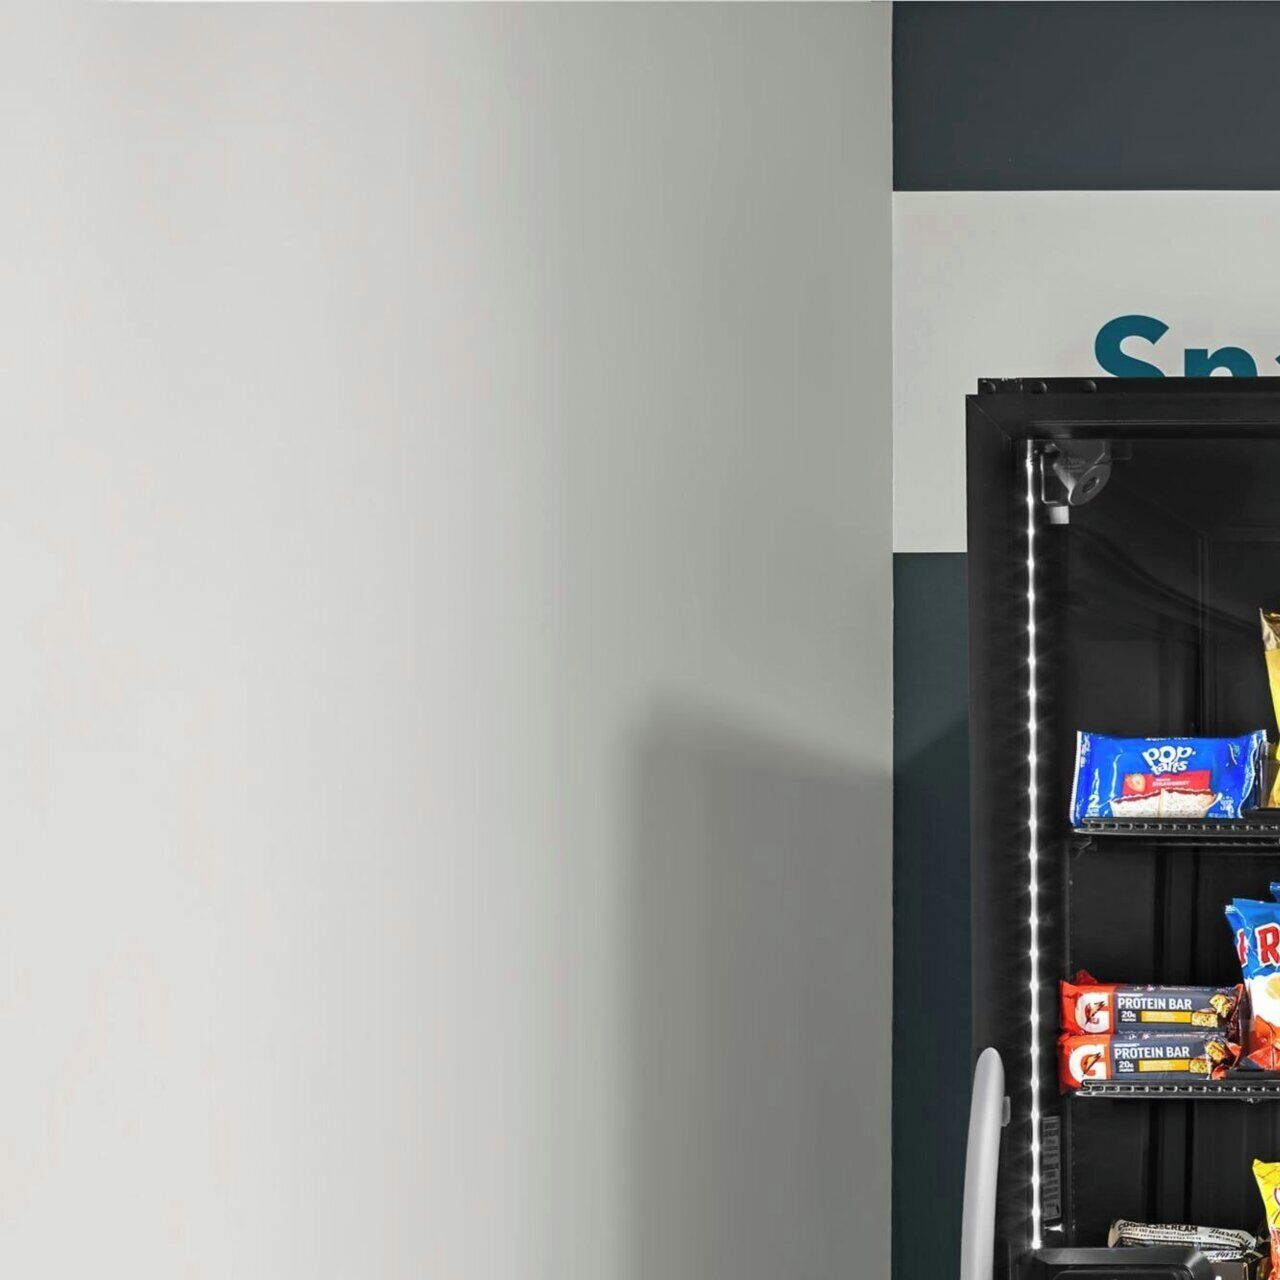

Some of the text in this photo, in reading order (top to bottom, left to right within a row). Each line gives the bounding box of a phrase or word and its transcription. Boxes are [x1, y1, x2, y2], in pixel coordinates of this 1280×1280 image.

[1117, 997, 1193, 1010] PROTEIN BAR
[1114, 1046, 1190, 1059] PROTEIN BAR
